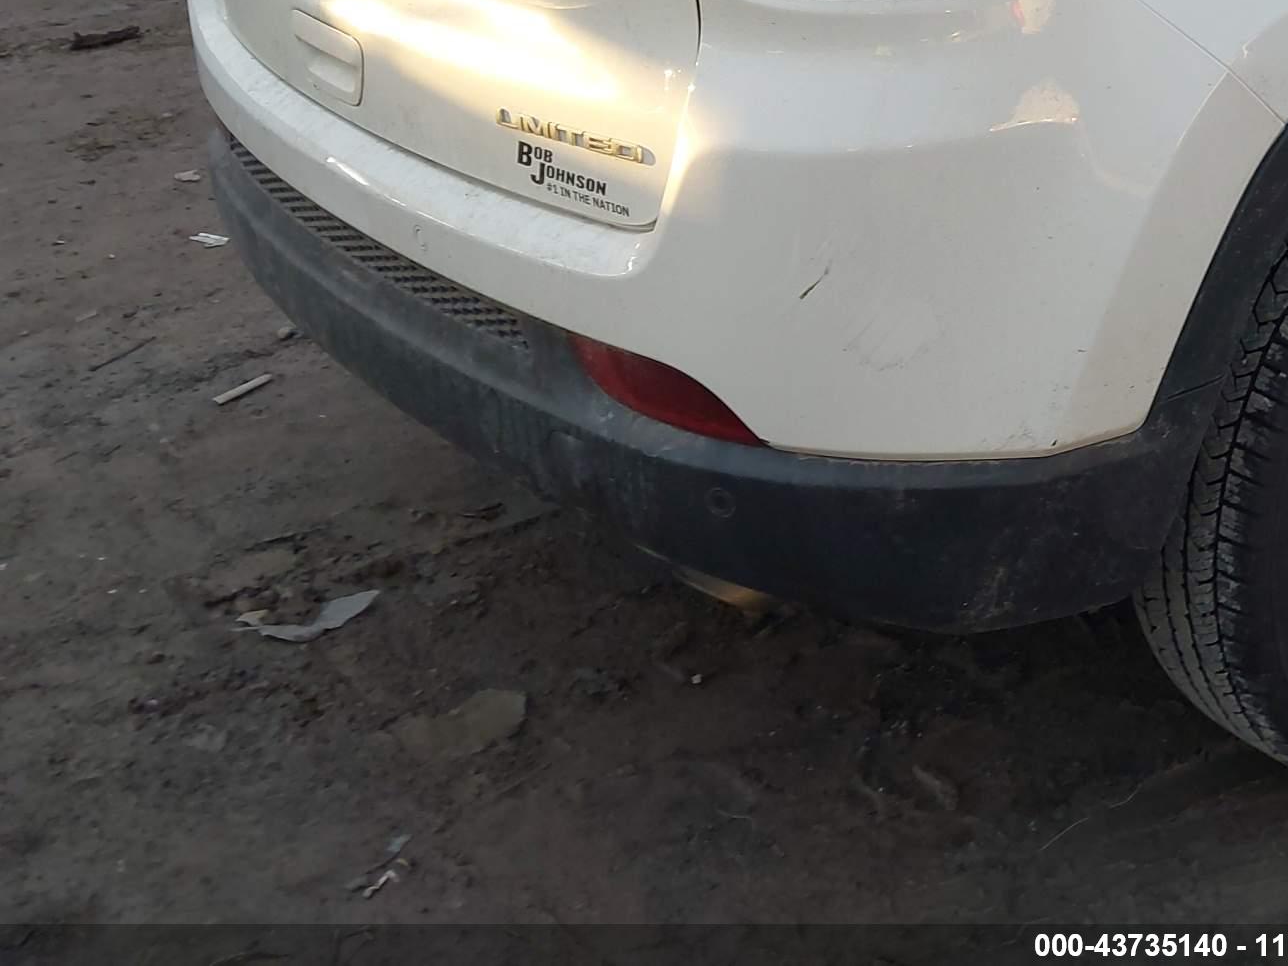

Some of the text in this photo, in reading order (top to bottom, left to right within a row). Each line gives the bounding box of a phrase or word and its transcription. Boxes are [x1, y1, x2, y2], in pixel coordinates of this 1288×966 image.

[496, 106, 656, 166] LIMITED
[517, 140, 553, 167] BOB
[530, 163, 607, 196] JOHNSON
[560, 185, 571, 199] IN
[573, 190, 590, 205] THE
[592, 196, 630, 217] NATION
